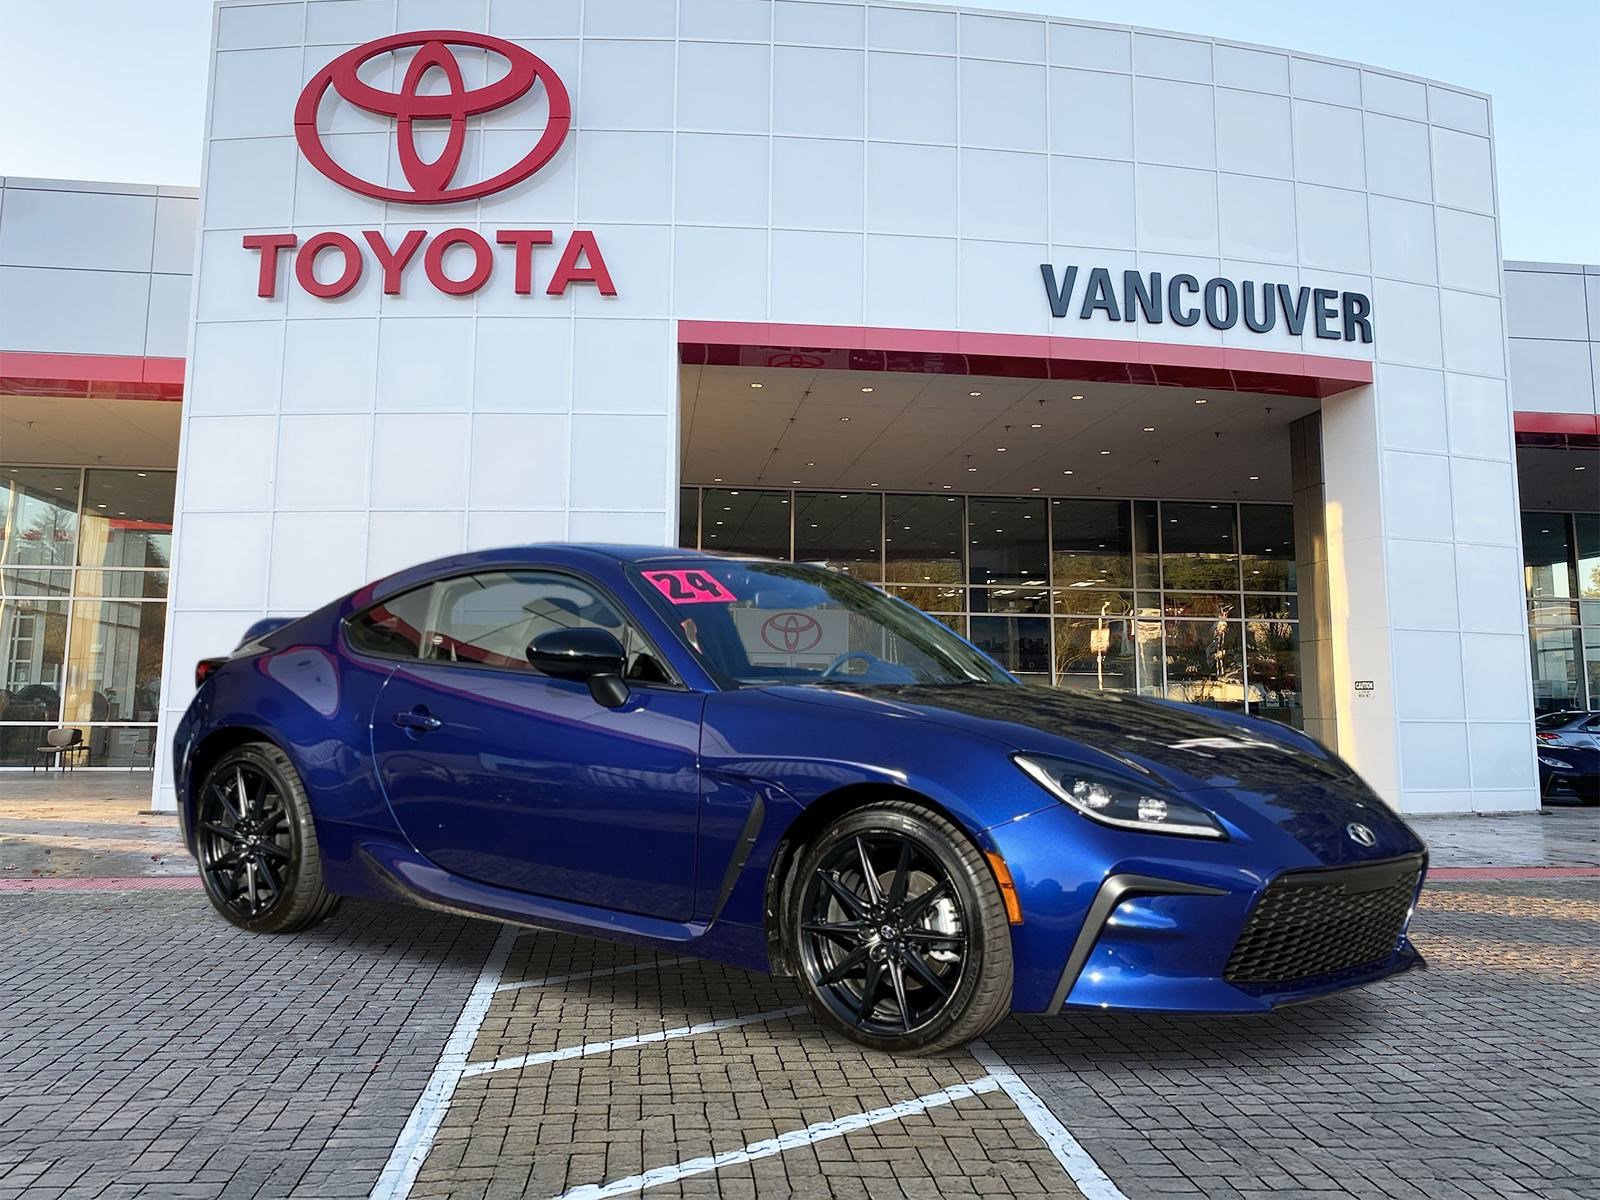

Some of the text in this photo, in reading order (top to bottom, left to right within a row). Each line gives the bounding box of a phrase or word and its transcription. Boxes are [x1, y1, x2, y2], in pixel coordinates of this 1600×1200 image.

[243, 228, 617, 298] TOYOTA
[1040, 264, 1373, 343] VANCOUVER
[653, 573, 722, 599] 24
